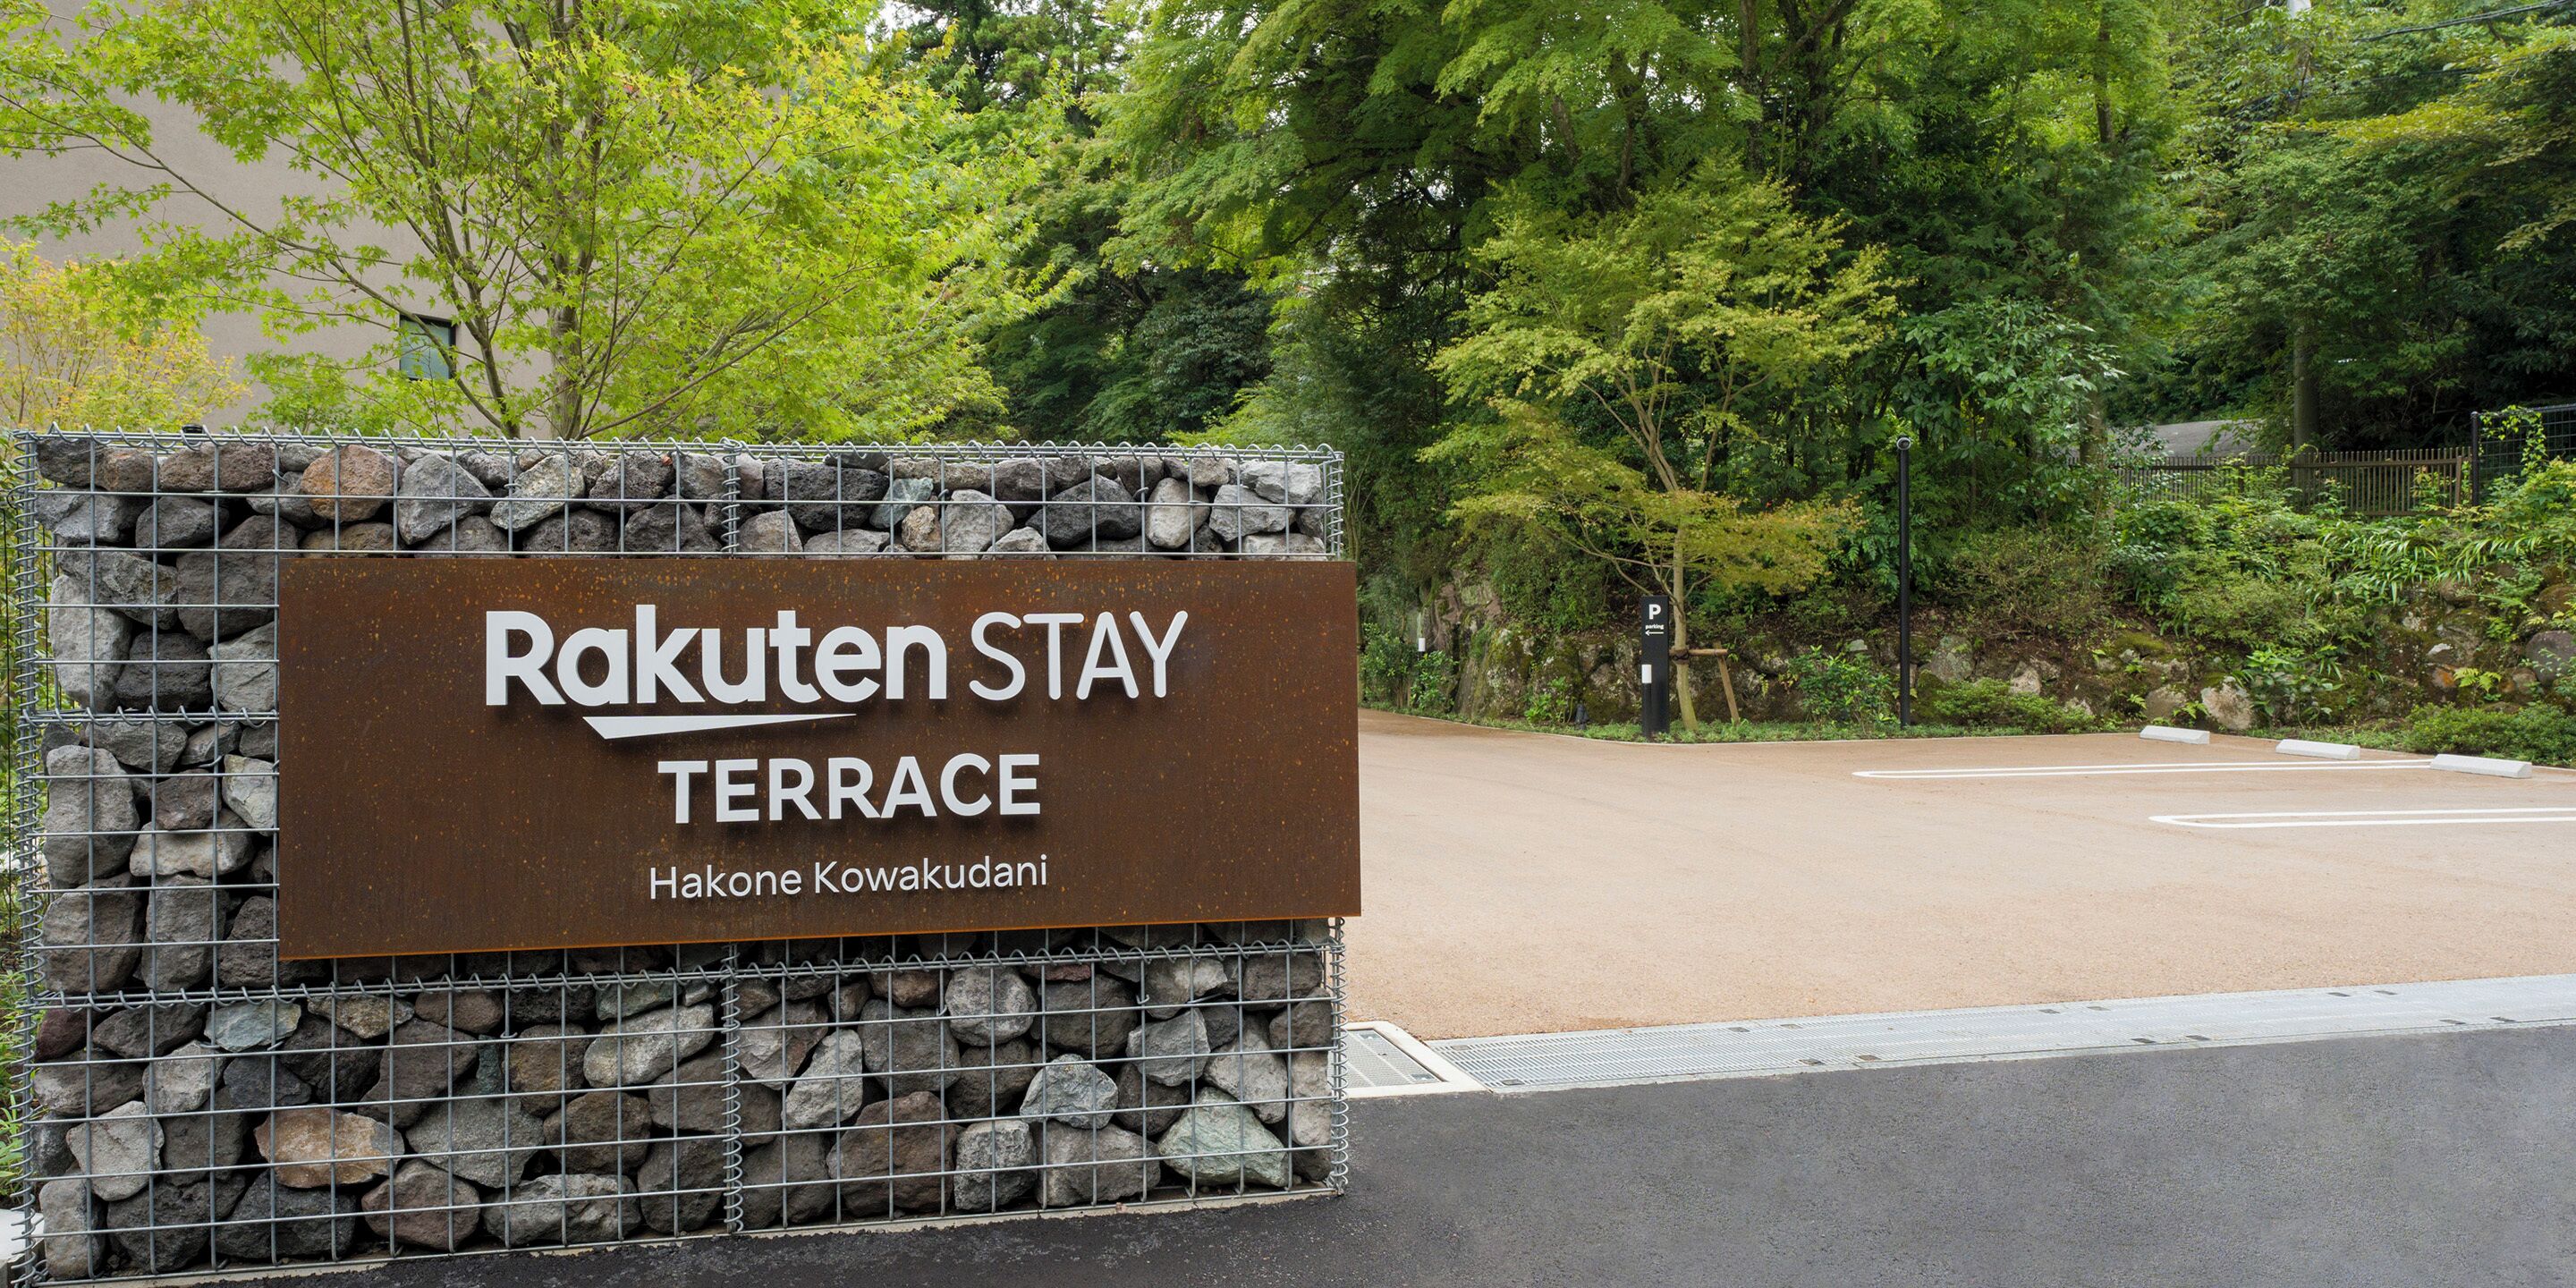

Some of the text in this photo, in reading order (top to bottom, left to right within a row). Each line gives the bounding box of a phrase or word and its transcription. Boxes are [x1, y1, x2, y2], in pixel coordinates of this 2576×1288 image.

[1648, 604, 1662, 620] P
[486, 605, 1189, 707] Rakuten STAY
[657, 752, 1041, 824] TERRACE
[650, 855, 1047, 900] Hakone Kowakudani
